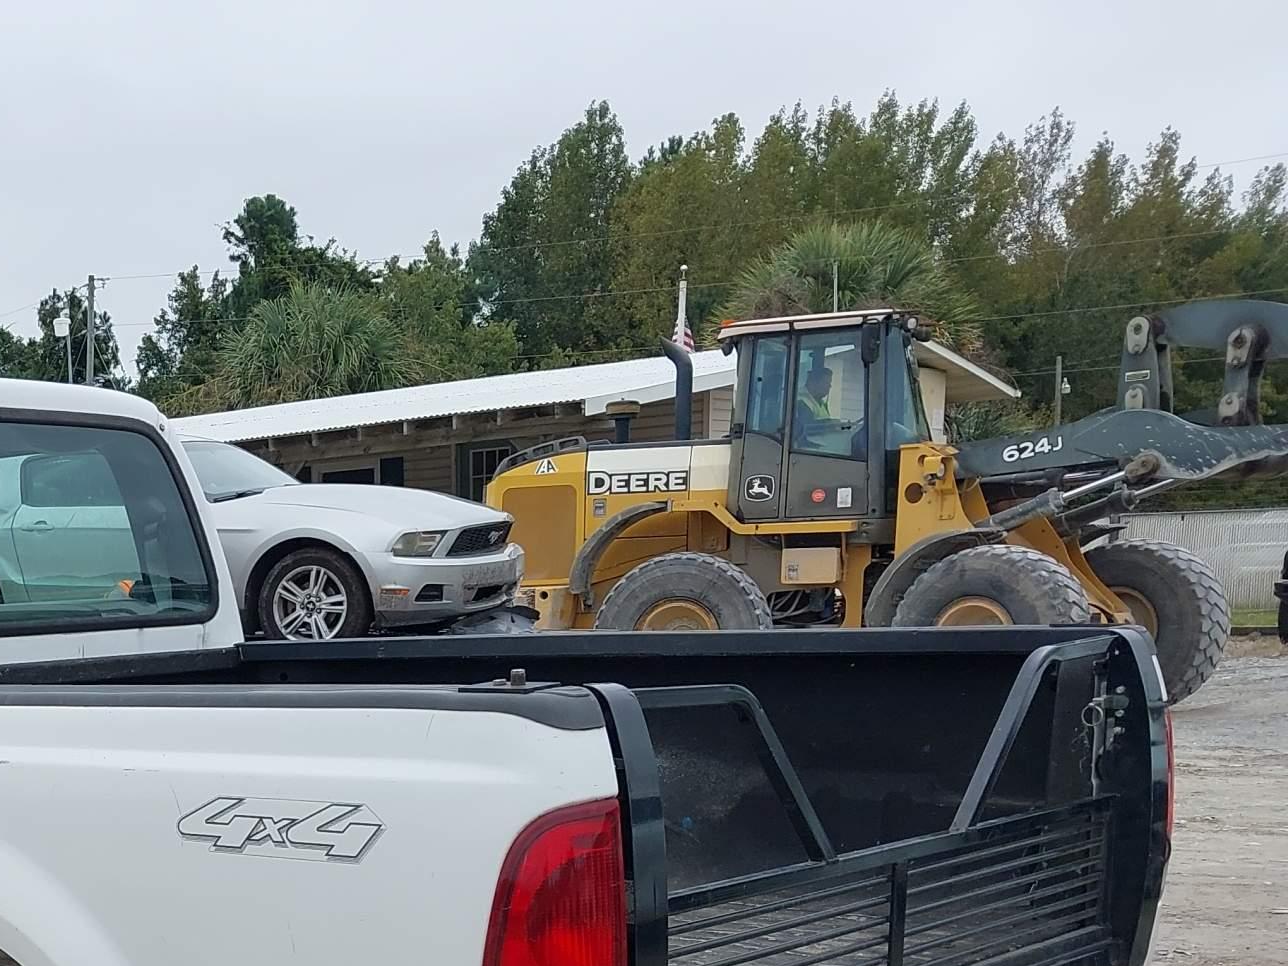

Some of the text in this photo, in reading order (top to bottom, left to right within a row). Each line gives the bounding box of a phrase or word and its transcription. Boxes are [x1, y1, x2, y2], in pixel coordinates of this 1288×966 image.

[1002, 436, 1063, 462] 624J
[588, 471, 688, 495] DEERE
[178, 797, 383, 859] 4x4
